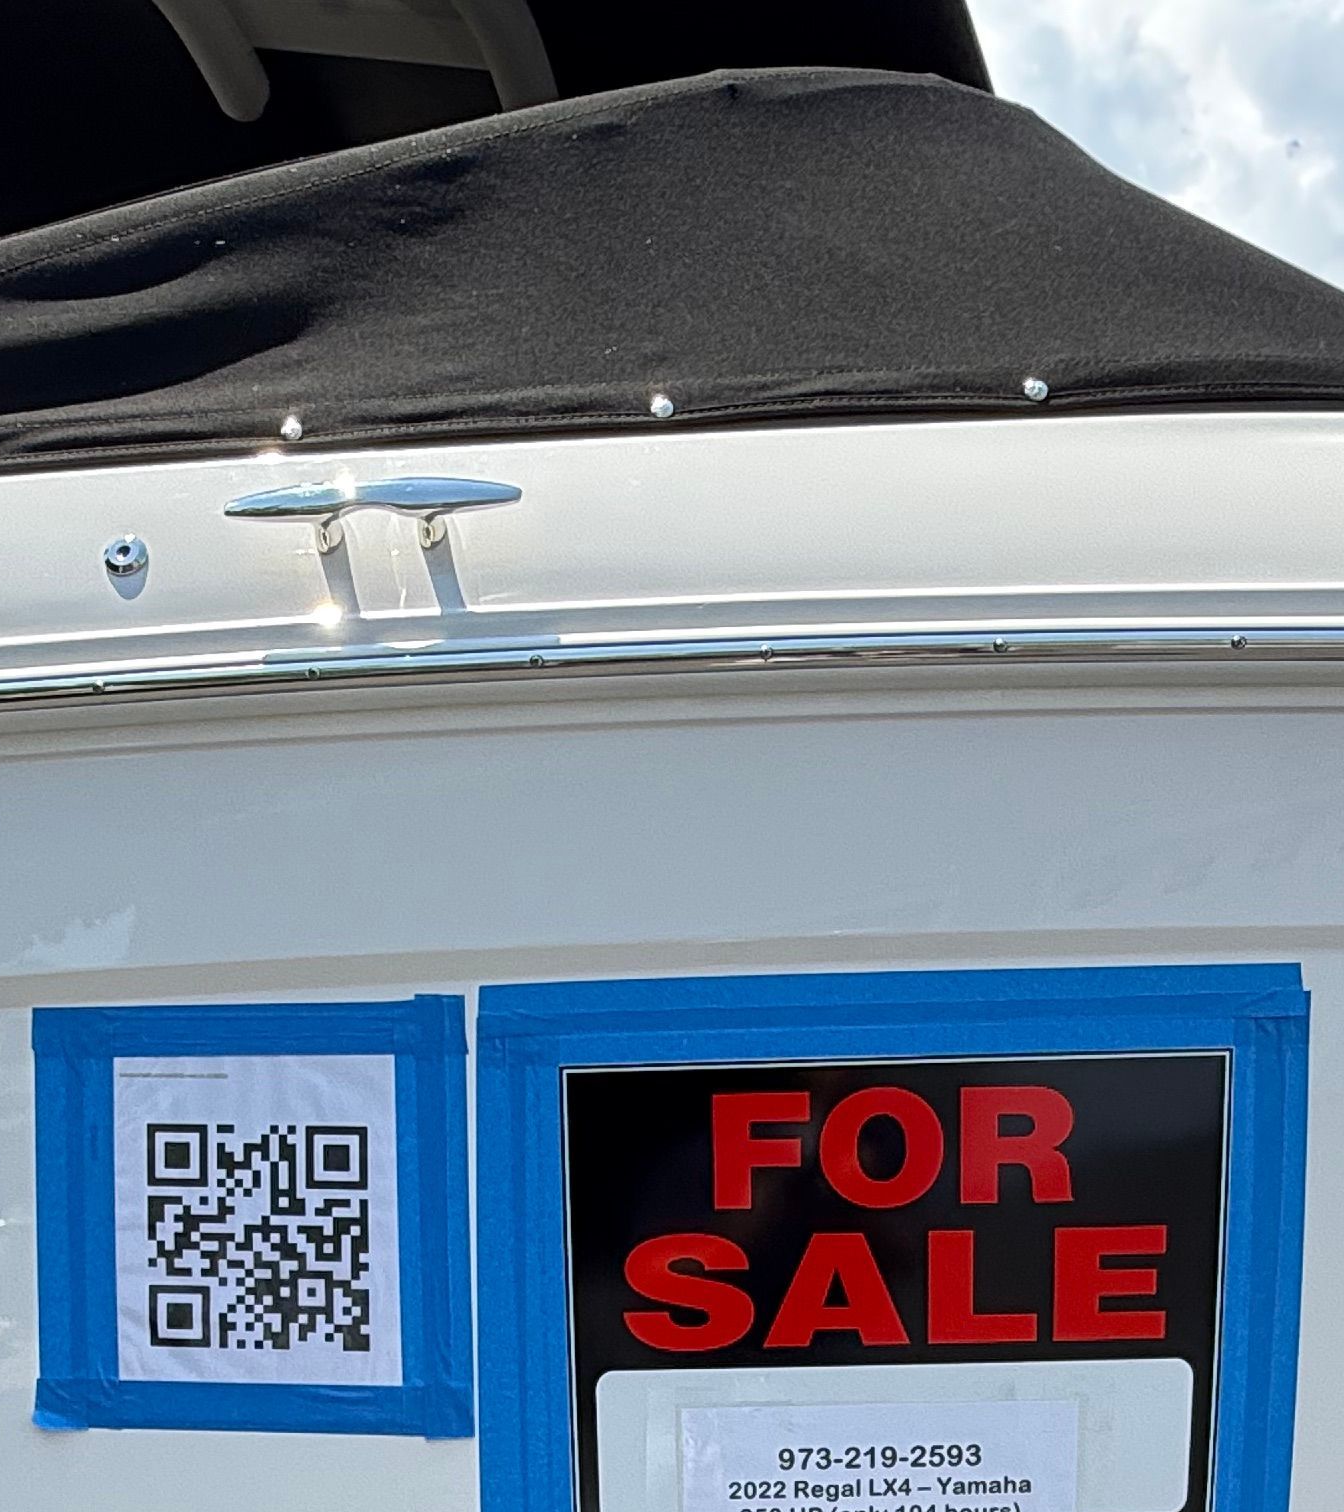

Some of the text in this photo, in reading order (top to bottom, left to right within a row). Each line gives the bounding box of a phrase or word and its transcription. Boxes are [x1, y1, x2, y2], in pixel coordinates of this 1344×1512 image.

[712, 1086, 1075, 1210] FOR
[623, 1225, 1167, 1351] SALE
[728, 1480, 787, 1501] 2022
[793, 1477, 862, 1503] Regal
[868, 1477, 913, 1498] LX4
[936, 1475, 1033, 1497] Yamaha
[777, 1442, 984, 1472] 973-219-2593
